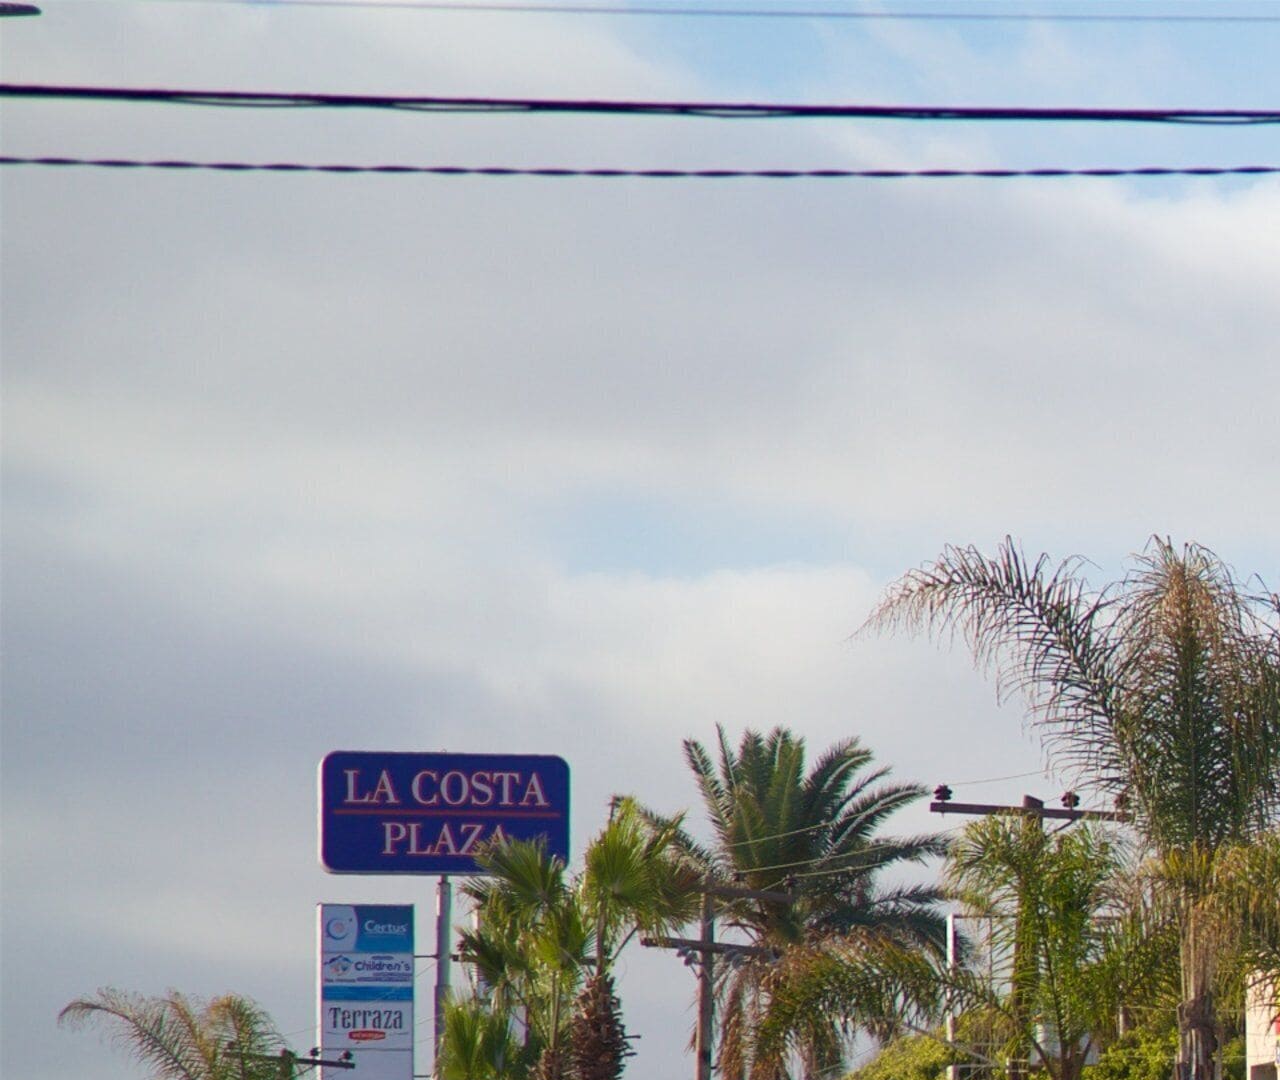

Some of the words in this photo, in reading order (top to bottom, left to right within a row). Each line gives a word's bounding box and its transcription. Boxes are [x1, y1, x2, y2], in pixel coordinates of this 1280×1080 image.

[343, 769, 400, 803] LA
[411, 770, 550, 806] COSTA
[329, 1007, 403, 1030] Terraza
